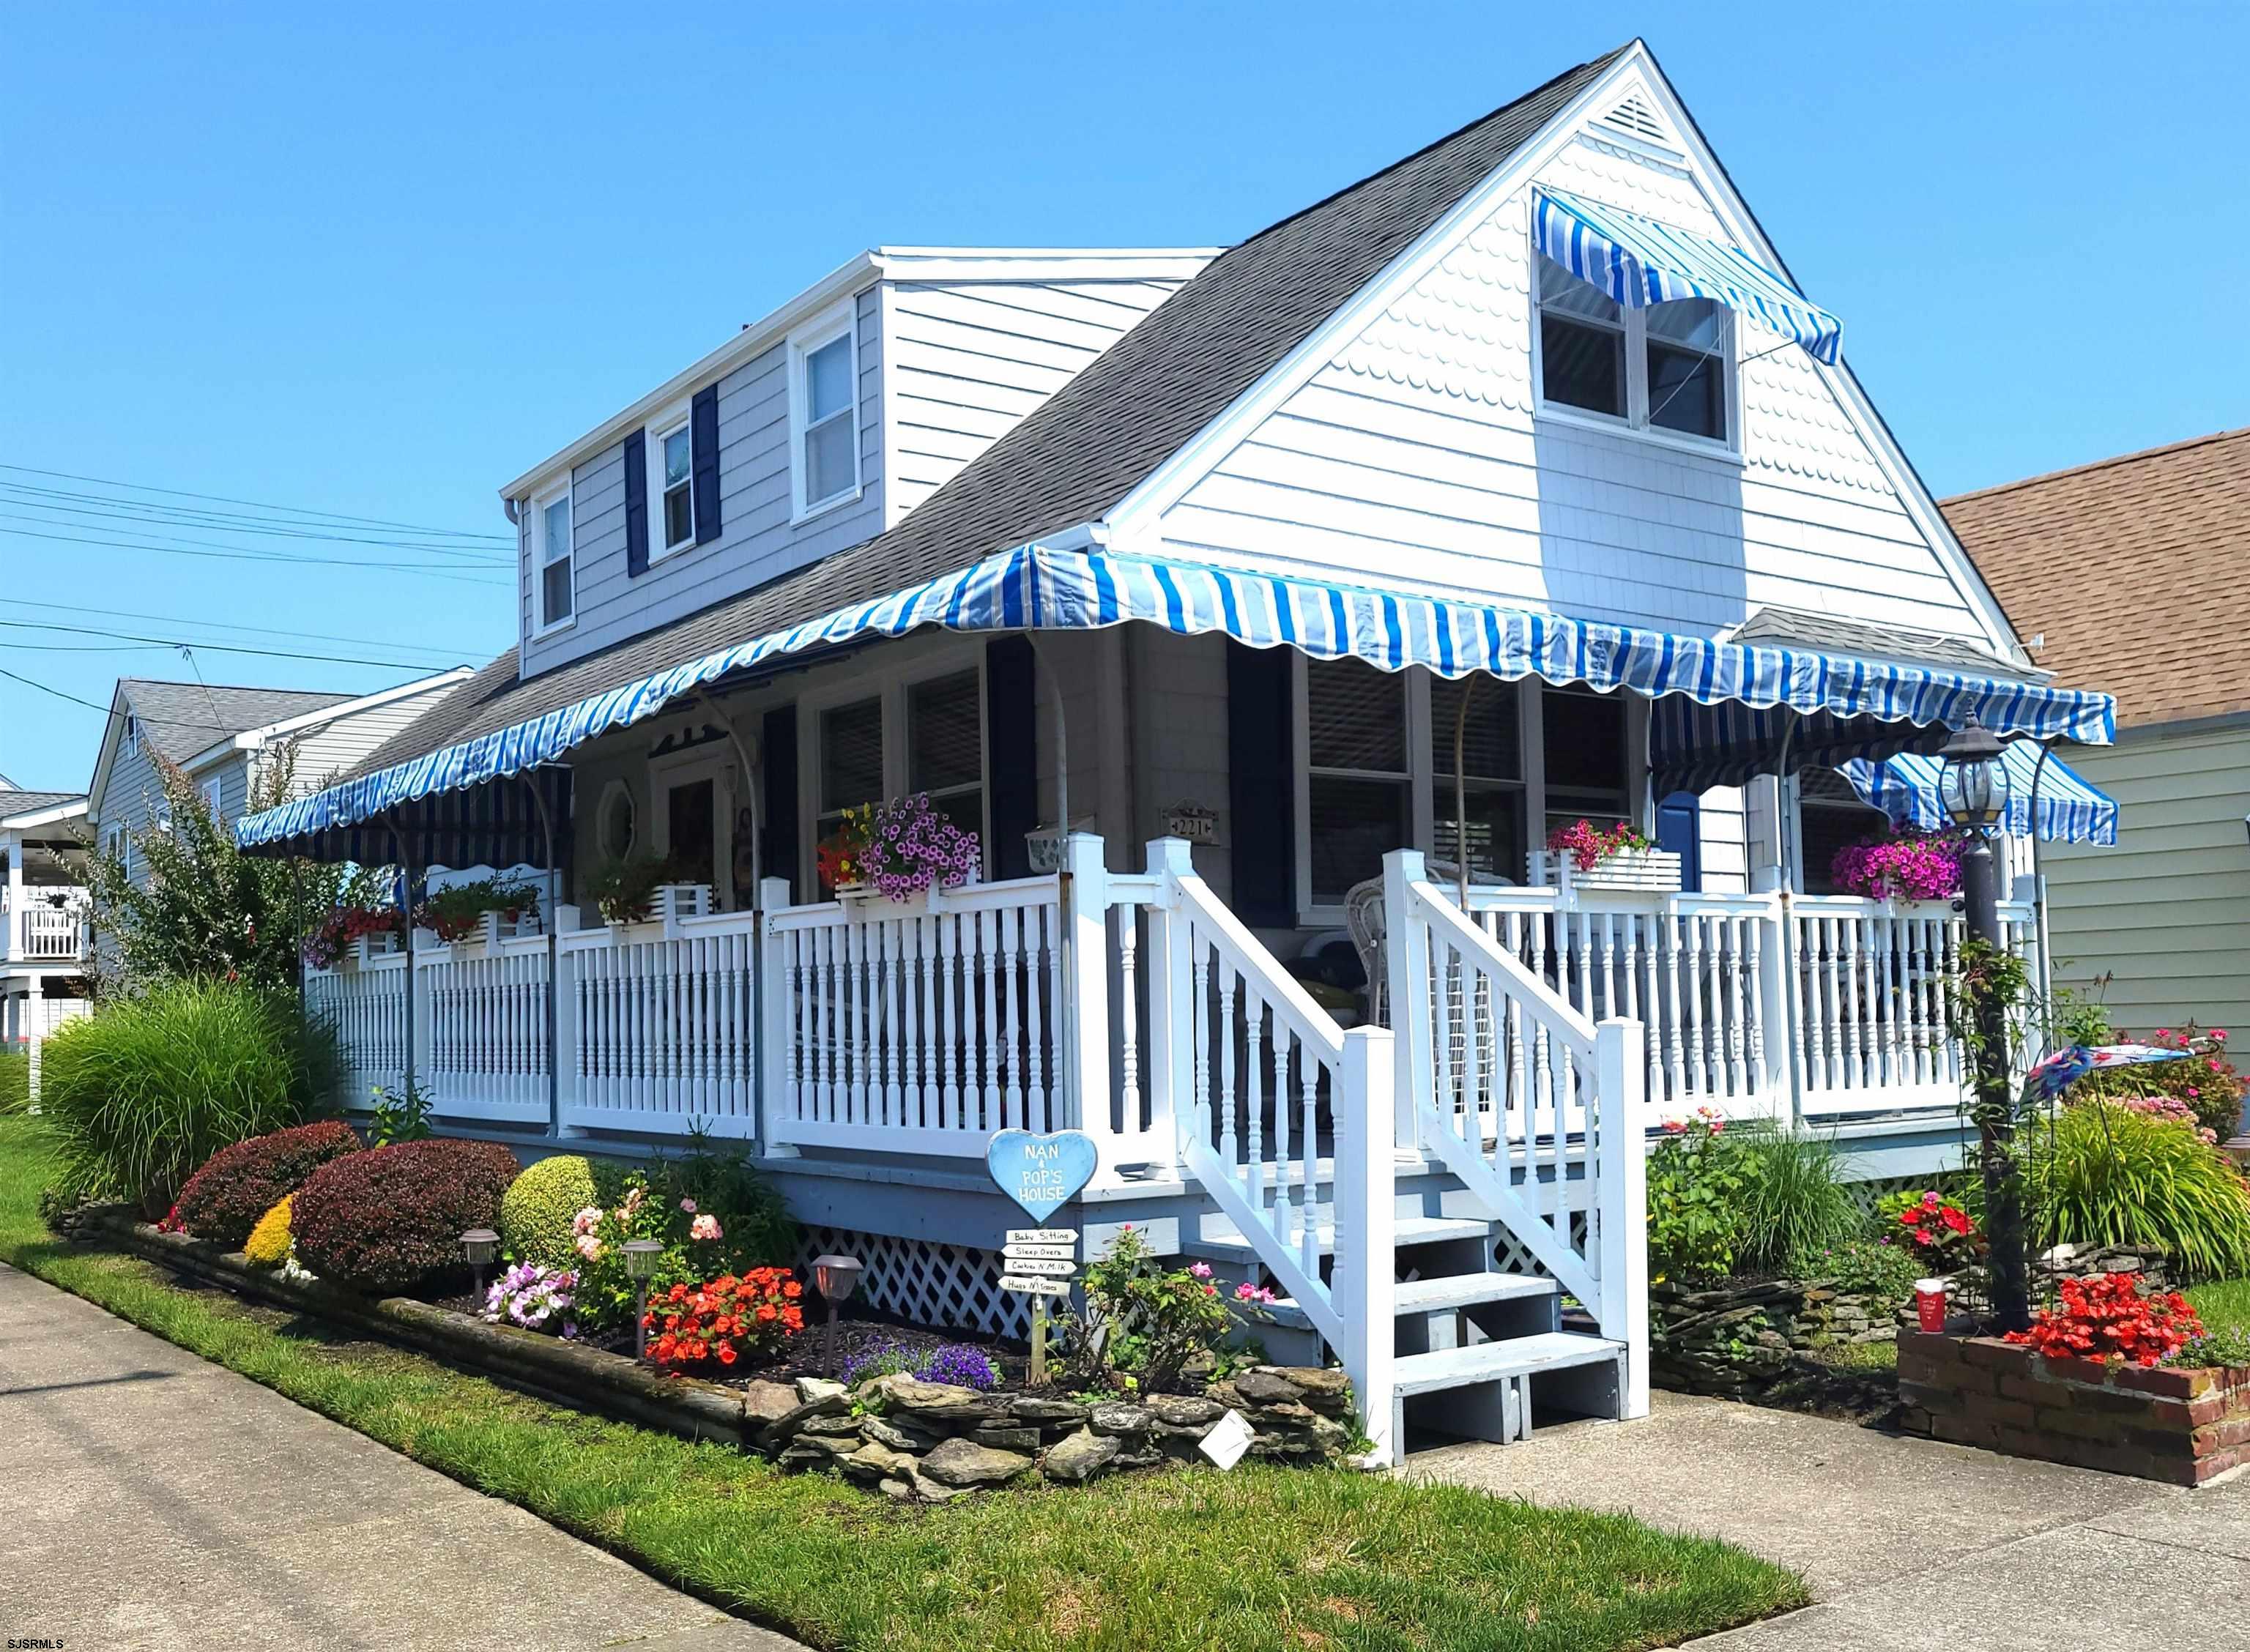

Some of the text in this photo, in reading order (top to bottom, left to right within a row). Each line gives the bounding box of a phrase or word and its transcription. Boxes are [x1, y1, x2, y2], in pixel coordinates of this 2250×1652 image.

[1180, 819, 1203, 835] 221
[1025, 1144, 1059, 1160] NAN
[1022, 1169, 1063, 1186] POP'S
[1019, 1186, 1067, 1202] HOUSE
[1014, 1232, 1069, 1241] Baby Sitting
[1016, 1247, 1038, 1256] Sleep
[1047, 1263, 1066, 1272] Milk
[1008, 1279, 1025, 1290] Hugs
